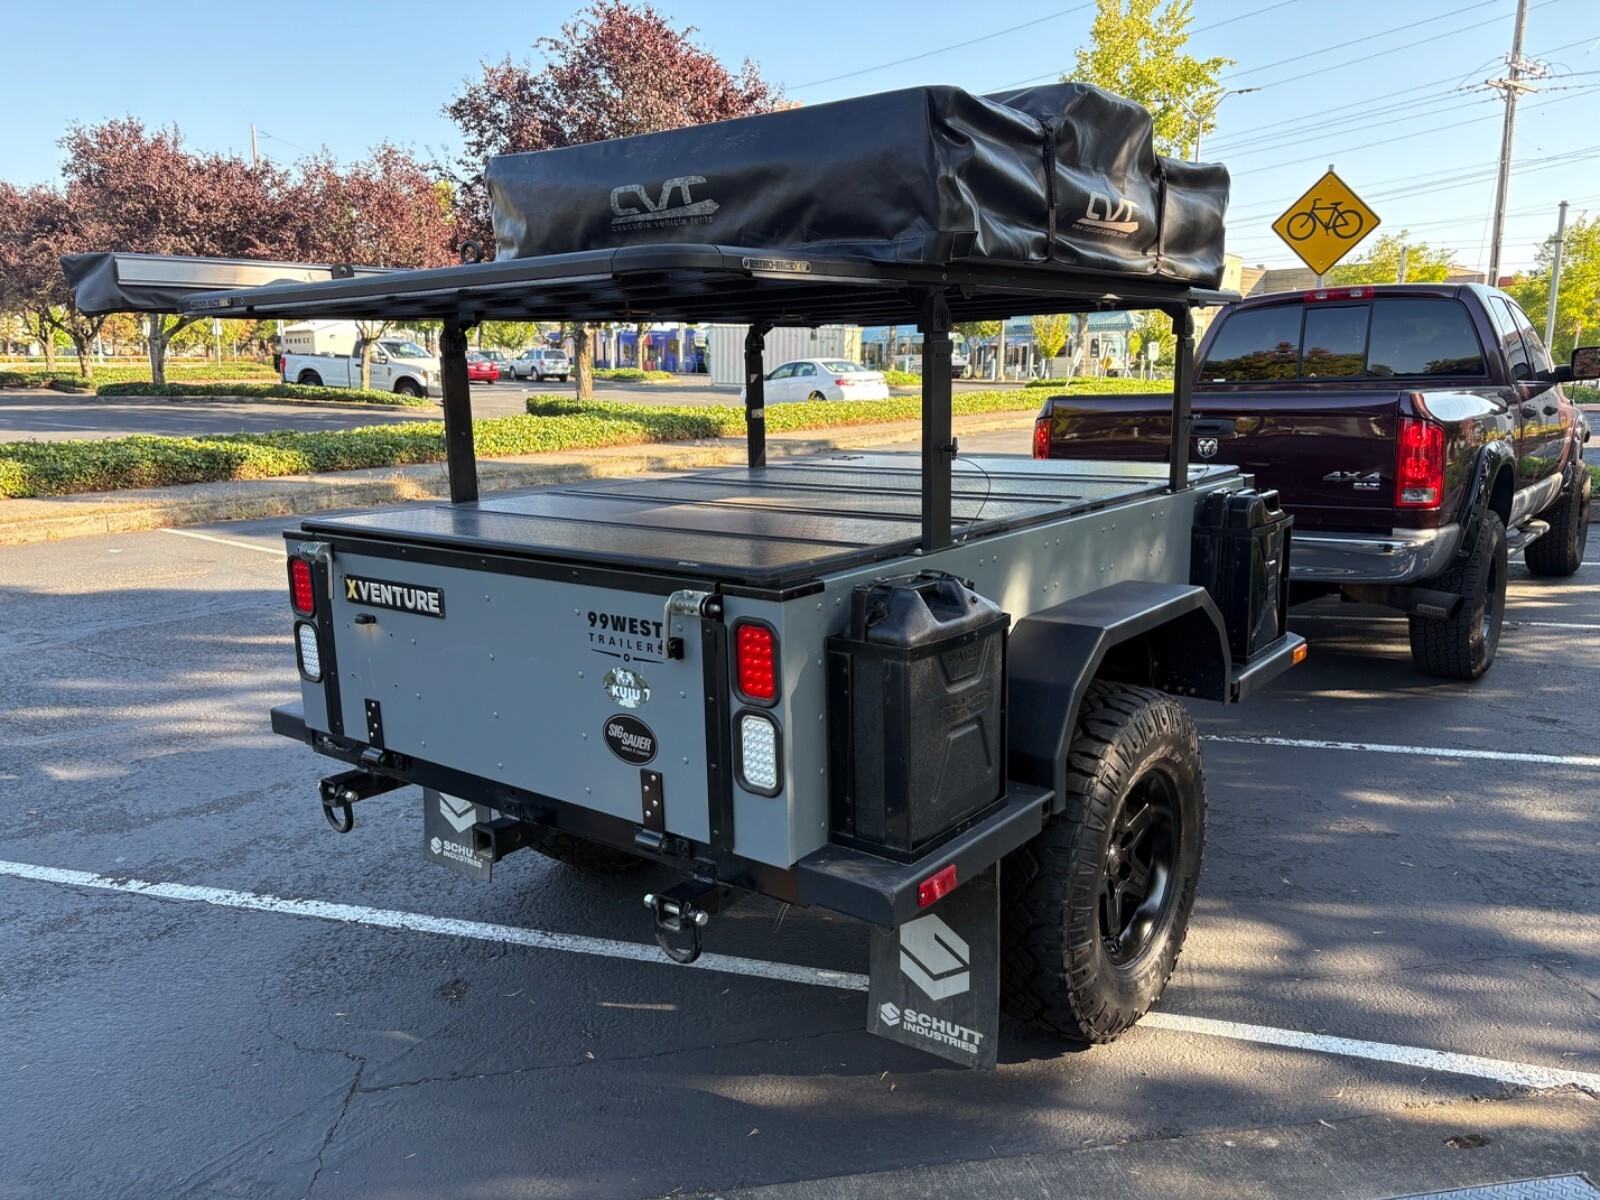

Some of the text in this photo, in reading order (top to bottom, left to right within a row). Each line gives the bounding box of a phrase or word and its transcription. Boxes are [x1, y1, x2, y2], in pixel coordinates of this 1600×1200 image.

[654, 217, 687, 228] vehicle
[346, 578, 440, 614] XVENTURE
[587, 611, 663, 639] 99WEST
[612, 684, 641, 701] KUIU
[608, 723, 652, 751] SIG SAUER
[443, 840, 482, 860] SCHU
[903, 1008, 984, 1046] SCHUTT
[903, 1021, 978, 1054] INDUSTRIES
